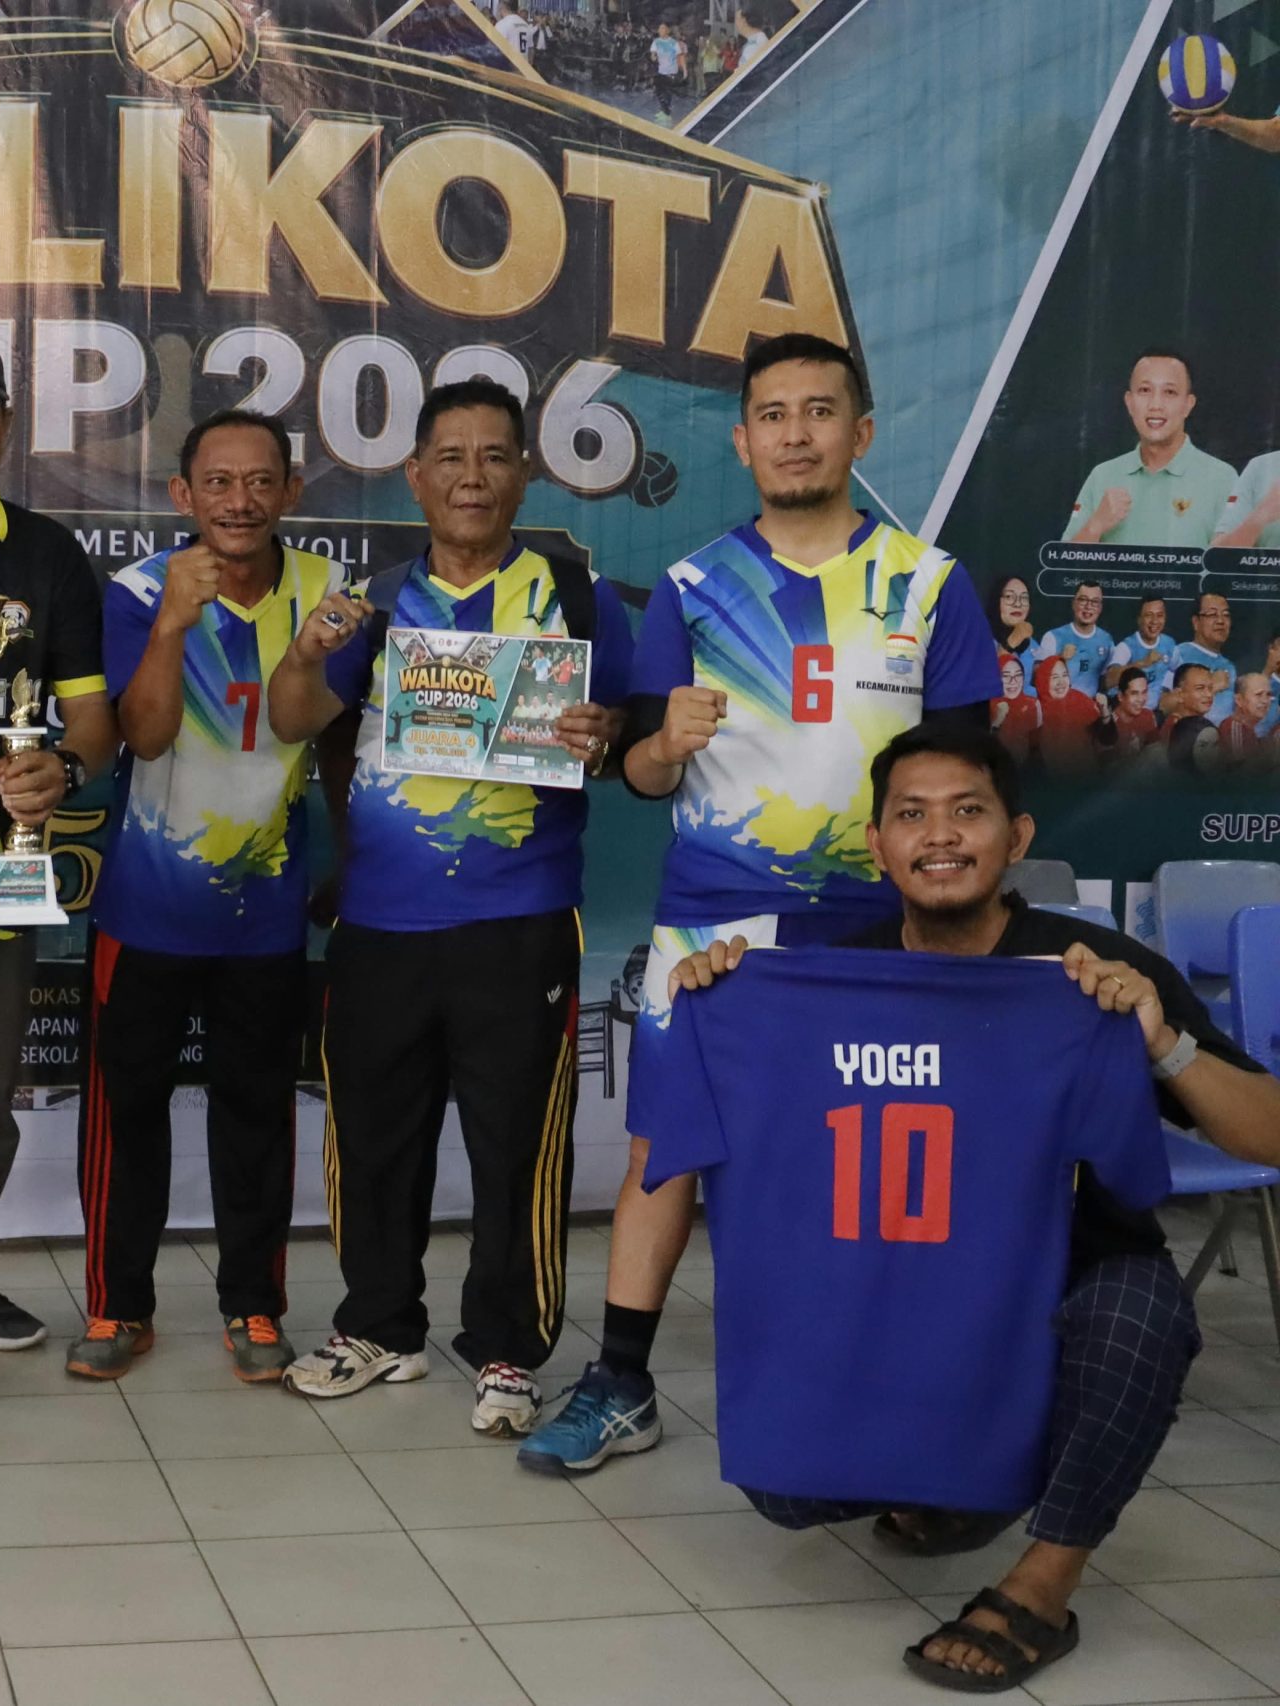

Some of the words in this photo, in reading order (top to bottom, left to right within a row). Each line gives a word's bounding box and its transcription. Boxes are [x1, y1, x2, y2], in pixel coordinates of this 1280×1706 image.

[74, 528, 156, 557] MEN
[1061, 551, 1117, 563] ADRIANUS
[1239, 556, 1258, 566] ADI
[400, 666, 497, 700] WALIKOTA
[792, 644, 834, 723] 6
[856, 680, 900, 693] KECAMATAN
[415, 690, 442, 707] CUP
[445, 690, 479, 711] 2026
[225, 682, 261, 752] 7
[465, 734, 476, 748] 4
[29, 987, 81, 1005] OKAS
[833, 1043, 941, 1087] YOGA
[826, 1103, 955, 1243] 10
